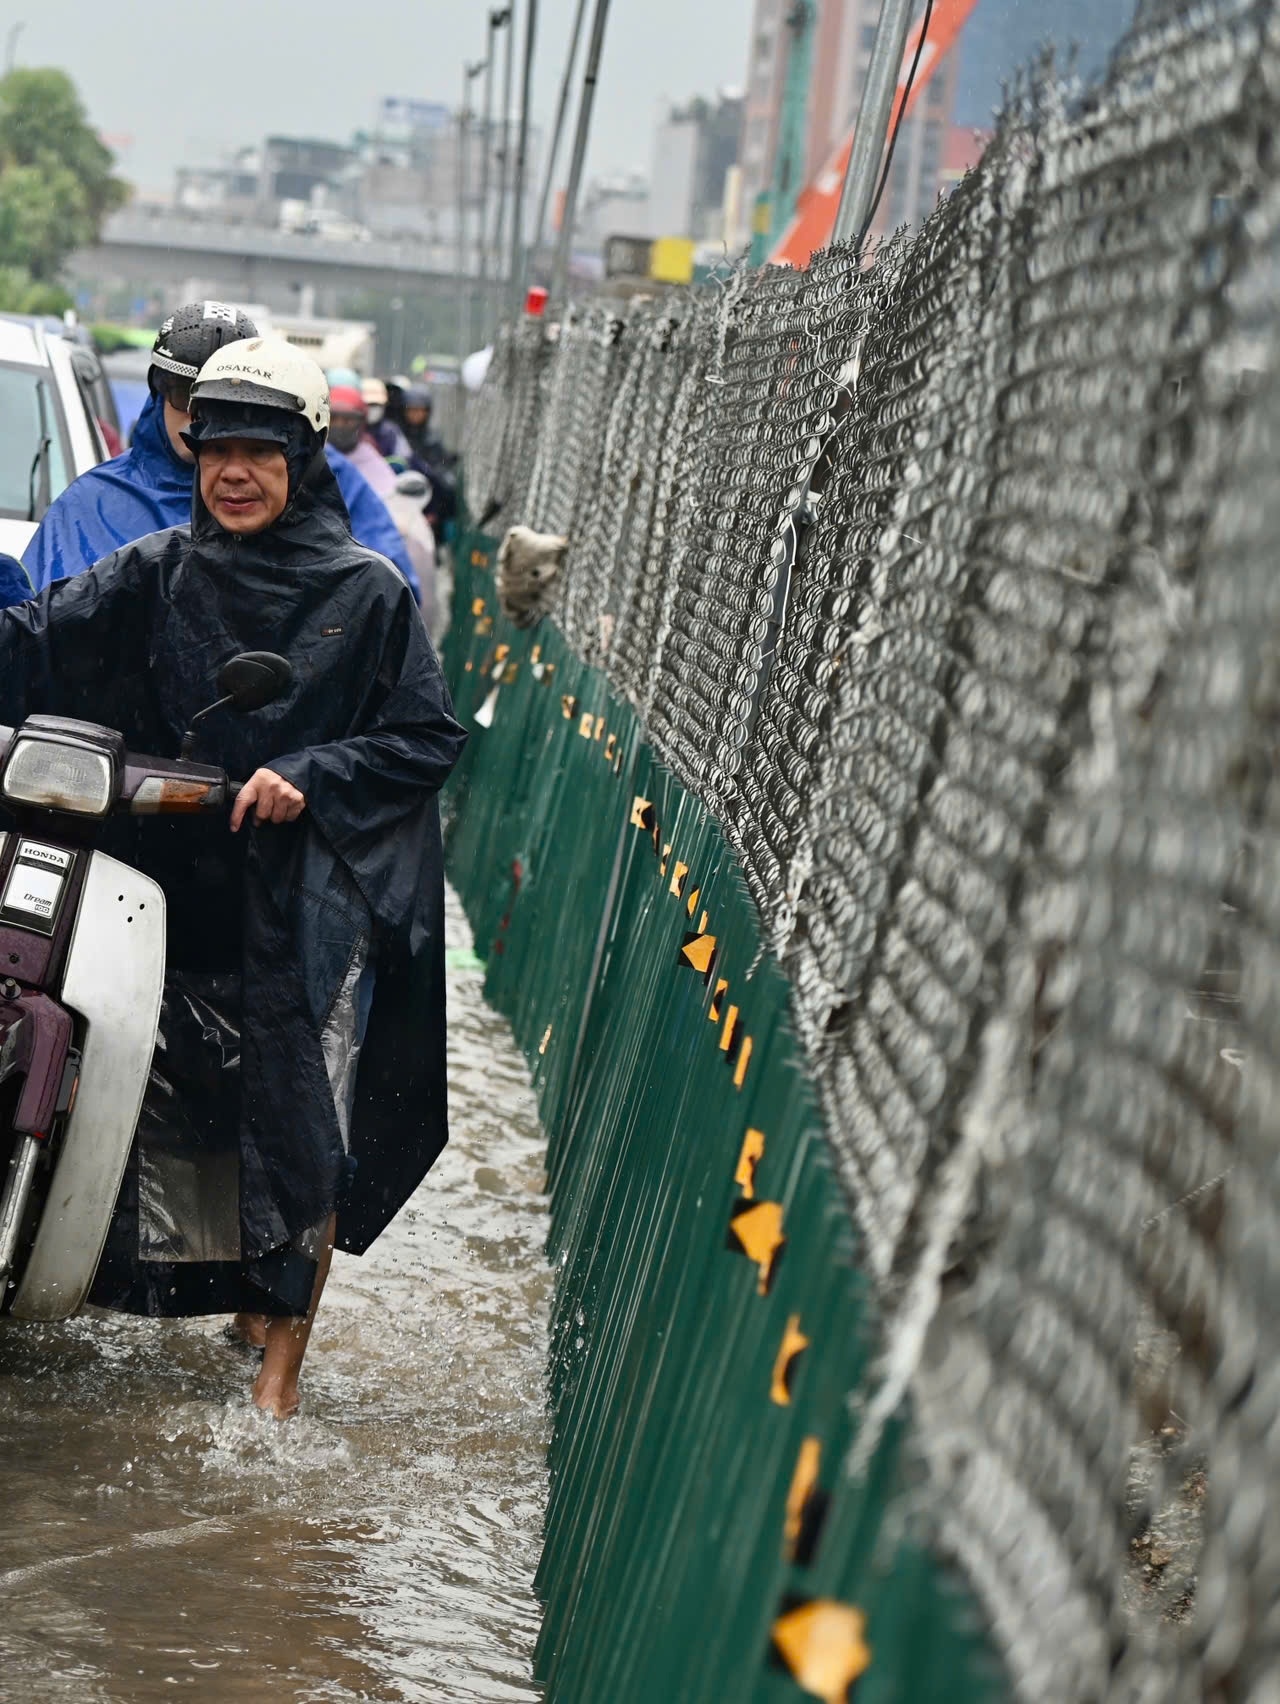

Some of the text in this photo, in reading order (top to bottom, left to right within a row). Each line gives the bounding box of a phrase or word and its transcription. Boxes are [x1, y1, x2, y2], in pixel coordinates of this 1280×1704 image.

[216, 364, 272, 379] OSAKAR
[24, 848, 65, 864] HONDA
[23, 893, 52, 906] Dream
